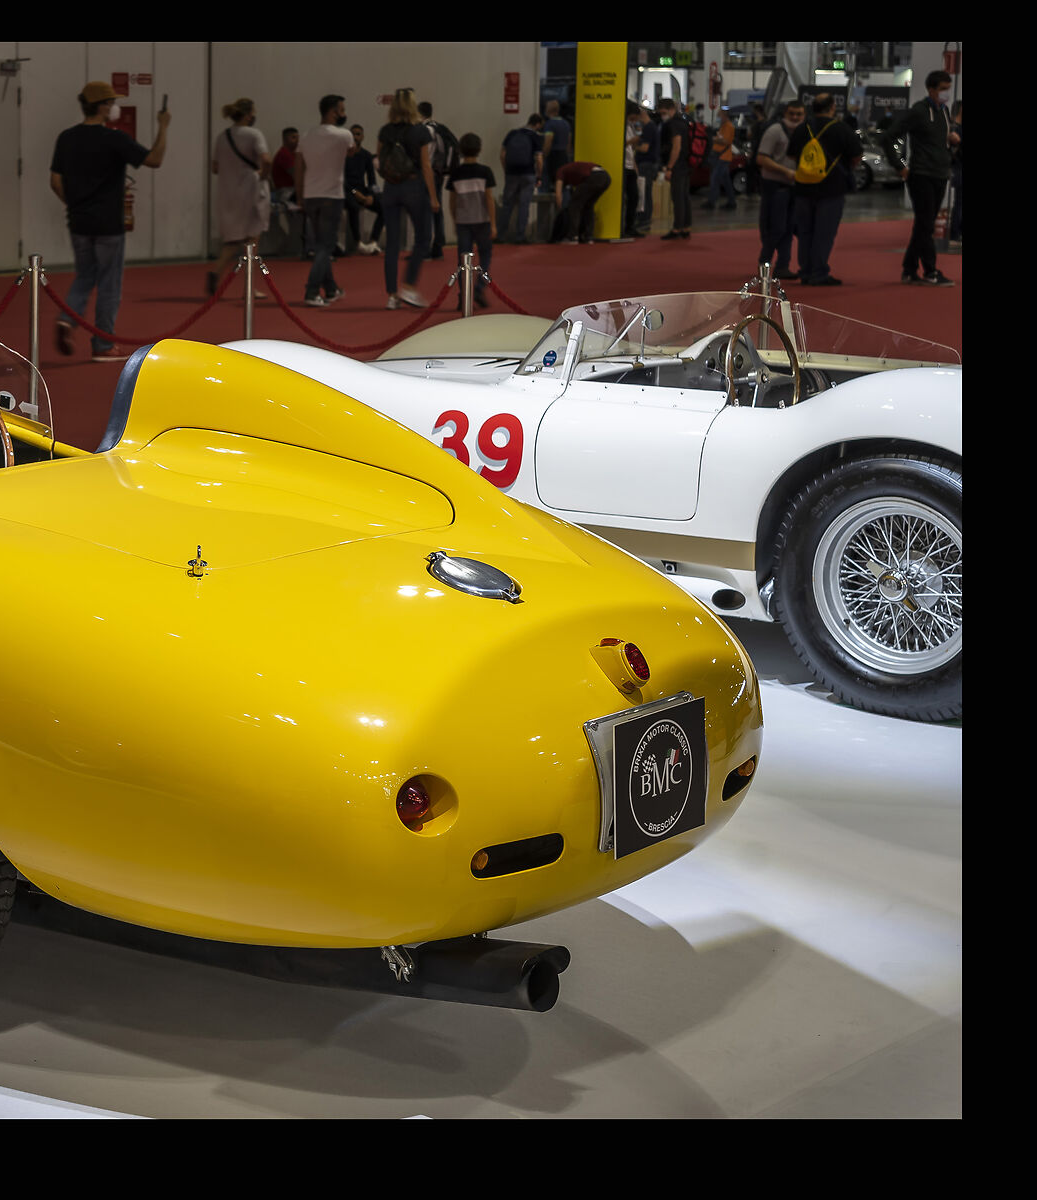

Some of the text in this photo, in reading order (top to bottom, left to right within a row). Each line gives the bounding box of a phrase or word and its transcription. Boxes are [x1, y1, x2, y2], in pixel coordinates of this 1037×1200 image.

[431, 409, 524, 493] 39
[633, 724, 689, 773] BRIXIA MOTOR CLASSIC
[640, 757, 683, 798] BMC
